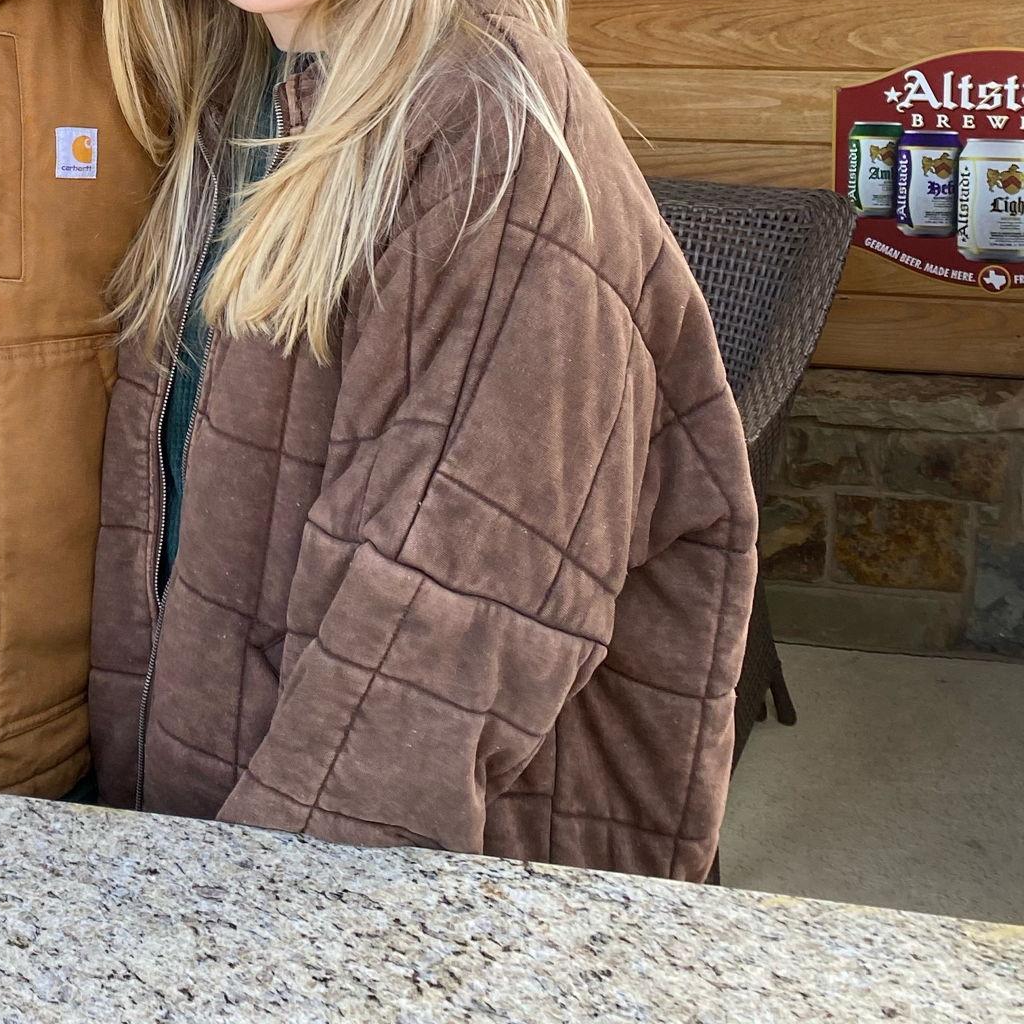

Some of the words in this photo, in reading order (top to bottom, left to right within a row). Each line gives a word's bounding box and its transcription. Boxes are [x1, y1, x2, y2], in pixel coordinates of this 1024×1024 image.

[896, 69, 1024, 113] Altst
[868, 166, 892, 180] Am
[989, 196, 1024, 217] Ligh
[864, 237, 900, 260] GERMAN
[900, 252, 923, 270] BEER.
[924, 263, 951, 278] MADE
[950, 270, 977, 283] HERE.
